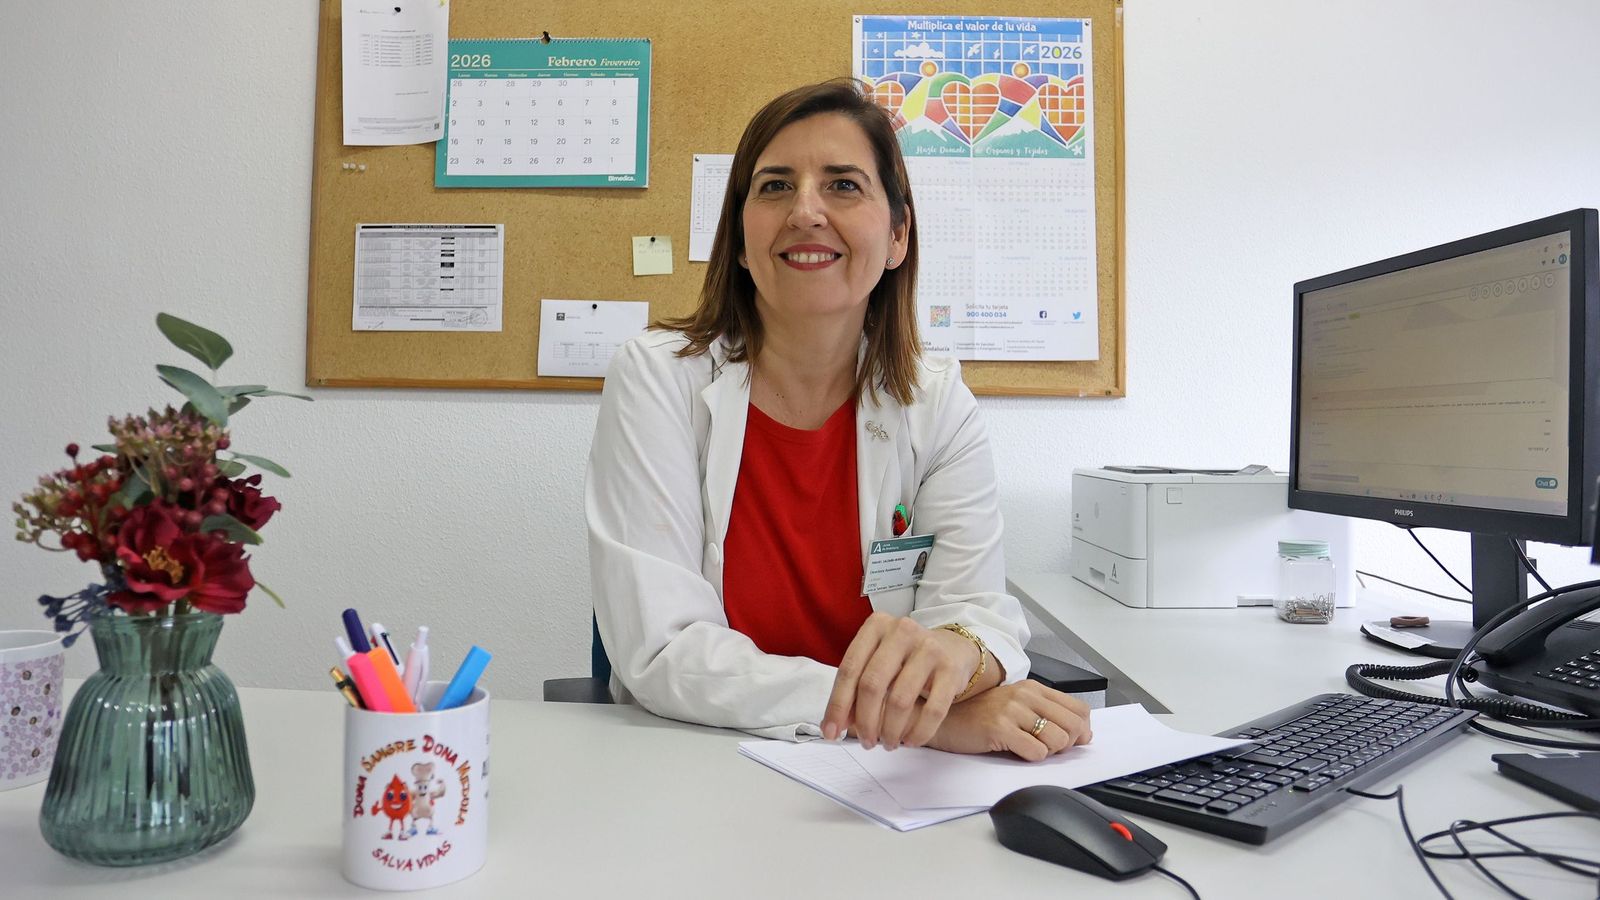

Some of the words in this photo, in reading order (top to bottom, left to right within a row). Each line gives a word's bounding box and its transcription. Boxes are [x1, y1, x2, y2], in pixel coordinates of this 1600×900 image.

[908, 20, 953, 32] Multiplica
[955, 22, 963, 30] el
[966, 22, 989, 31] valor
[992, 22, 1004, 31] de
[1006, 22, 1014, 31] tu
[1016, 22, 1036, 32] vida
[1041, 46, 1082, 60] 2026
[450, 54, 491, 68] 2026
[548, 56, 596, 67] Febrero
[600, 58, 640, 67] Fevereiro
[1394, 508, 1414, 517] PHILIPS
[372, 848, 412, 872] SALVA
[416, 840, 451, 870] VIDAS
